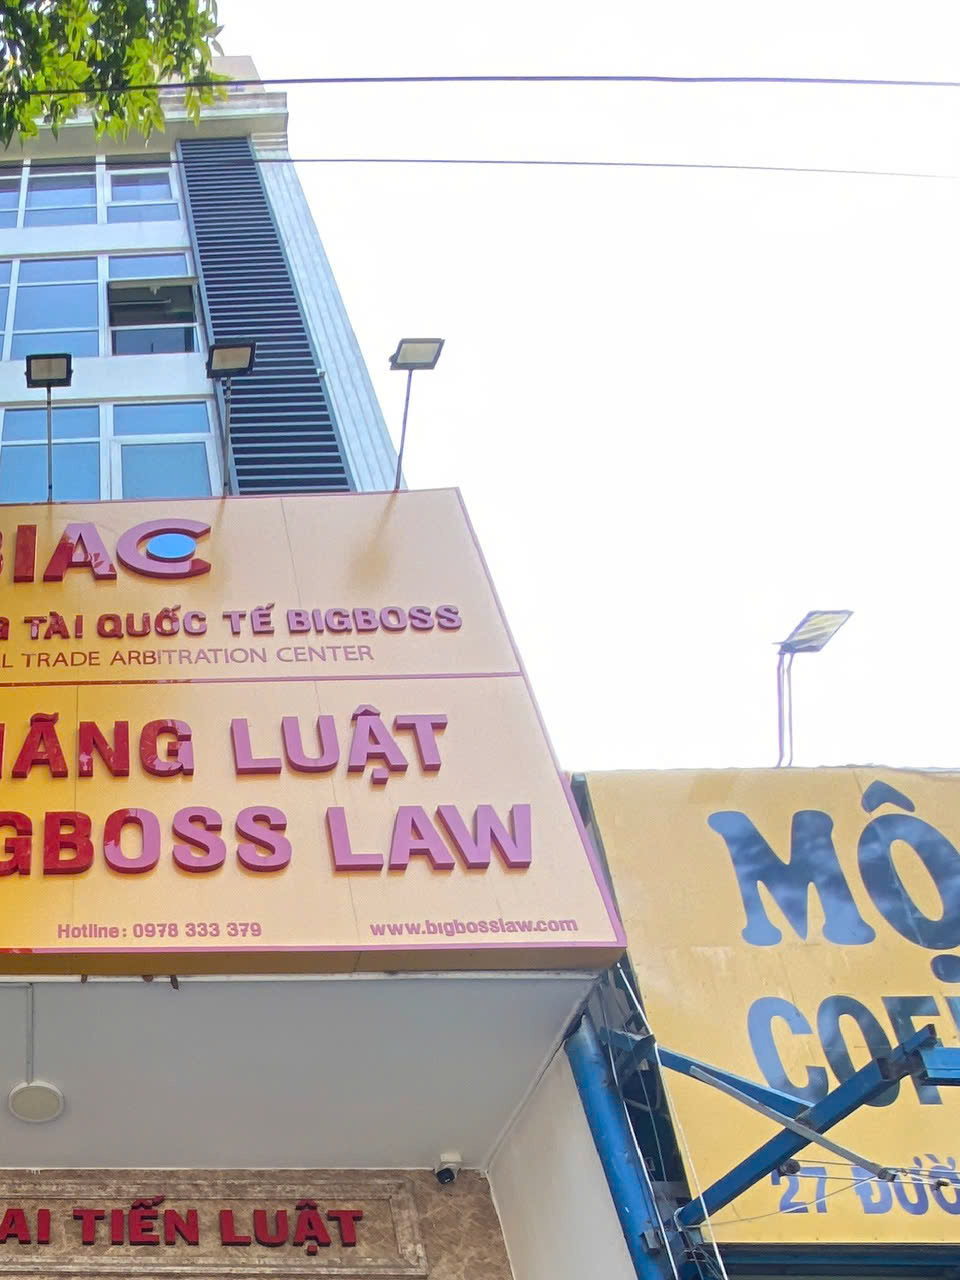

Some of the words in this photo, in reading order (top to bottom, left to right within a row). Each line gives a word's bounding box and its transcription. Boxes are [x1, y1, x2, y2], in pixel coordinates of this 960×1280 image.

[24, 610, 84, 640] TÀI
[97, 604, 208, 639] QUỐC
[222, 602, 276, 635] TẾ
[286, 604, 463, 634] BIGBOSS
[21, 650, 101, 667] TRADE
[109, 647, 268, 665] ARBITRATION
[276, 644, 375, 662] CENTER
[230, 704, 448, 785] LUẬT
[326, 803, 532, 872] LAW
[133, 923, 178, 938] 0978
[185, 922, 220, 937] 333
[227, 922, 262, 937] 379
[370, 918, 578, 936] www.bigbosslaw.com
[771, 1165, 828, 1213] 27
[73, 1195, 199, 1246] TIẾN
[219, 1200, 363, 1256] LUẬT
